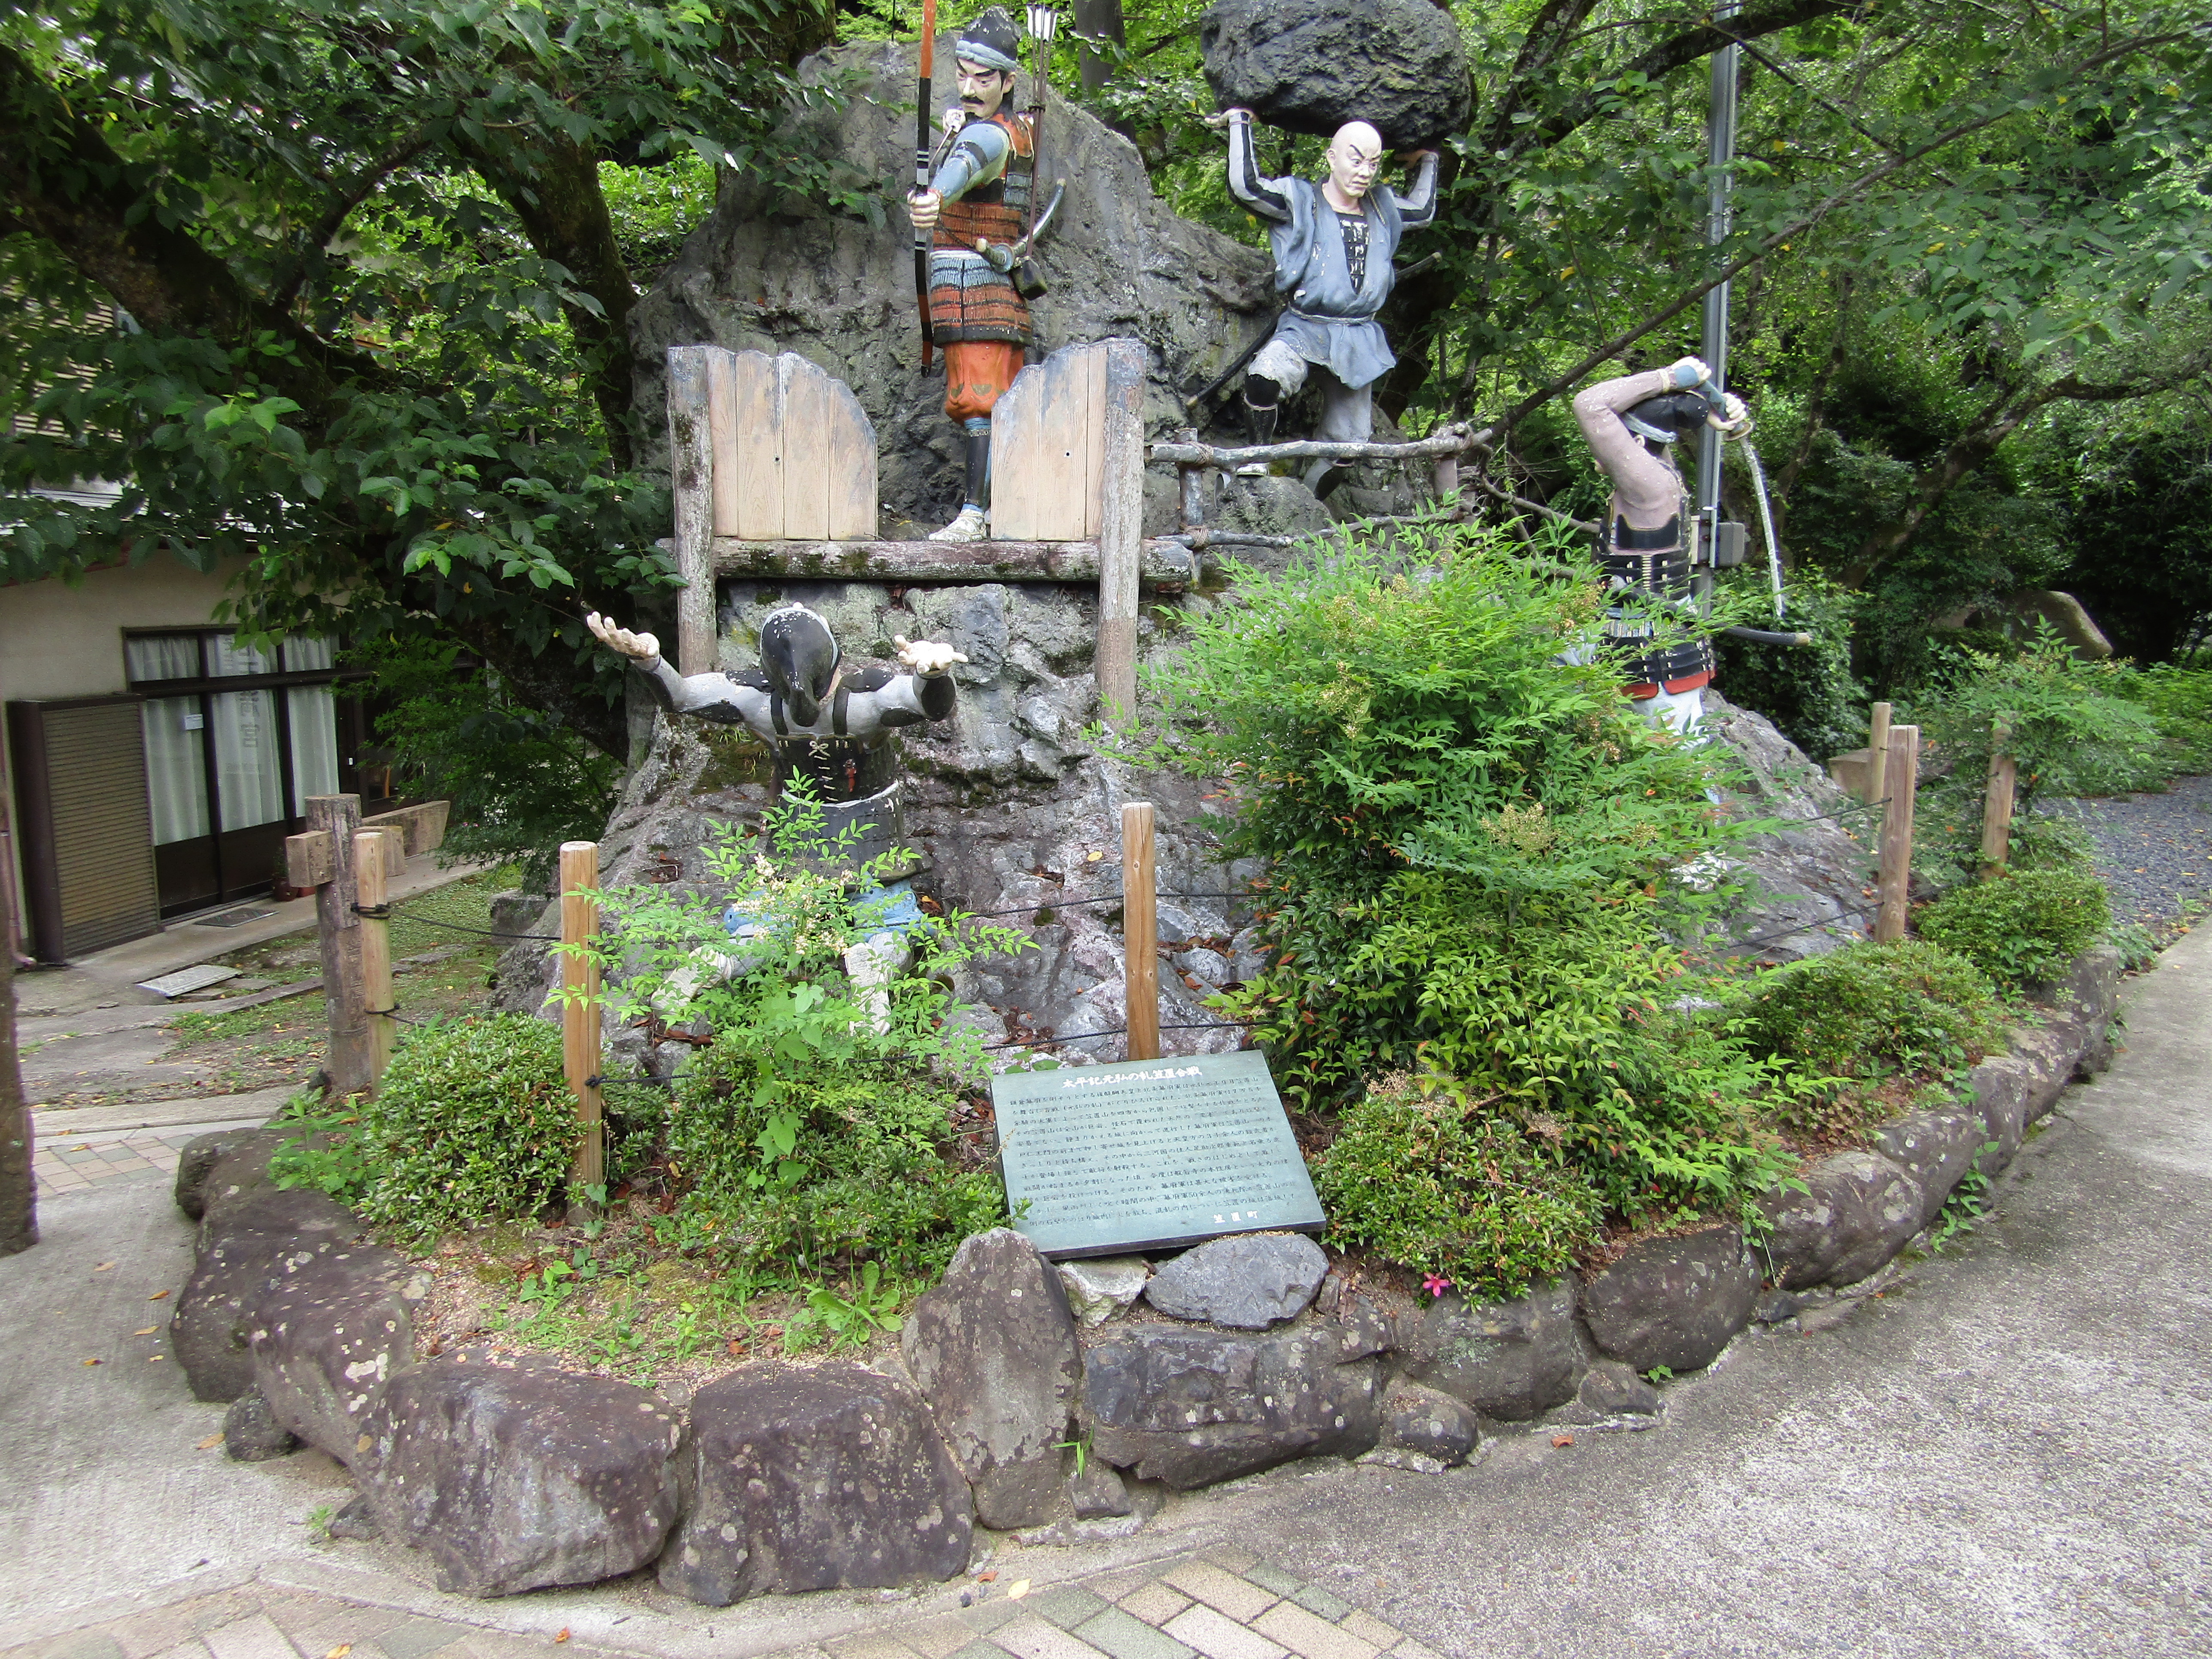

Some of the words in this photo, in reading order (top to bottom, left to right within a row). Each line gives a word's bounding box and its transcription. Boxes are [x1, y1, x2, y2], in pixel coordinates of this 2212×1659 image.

[1062, 1065, 1203, 1090] 太平記元弘の乱笠置合戦
[1211, 1209, 1260, 1224] 笠置町
